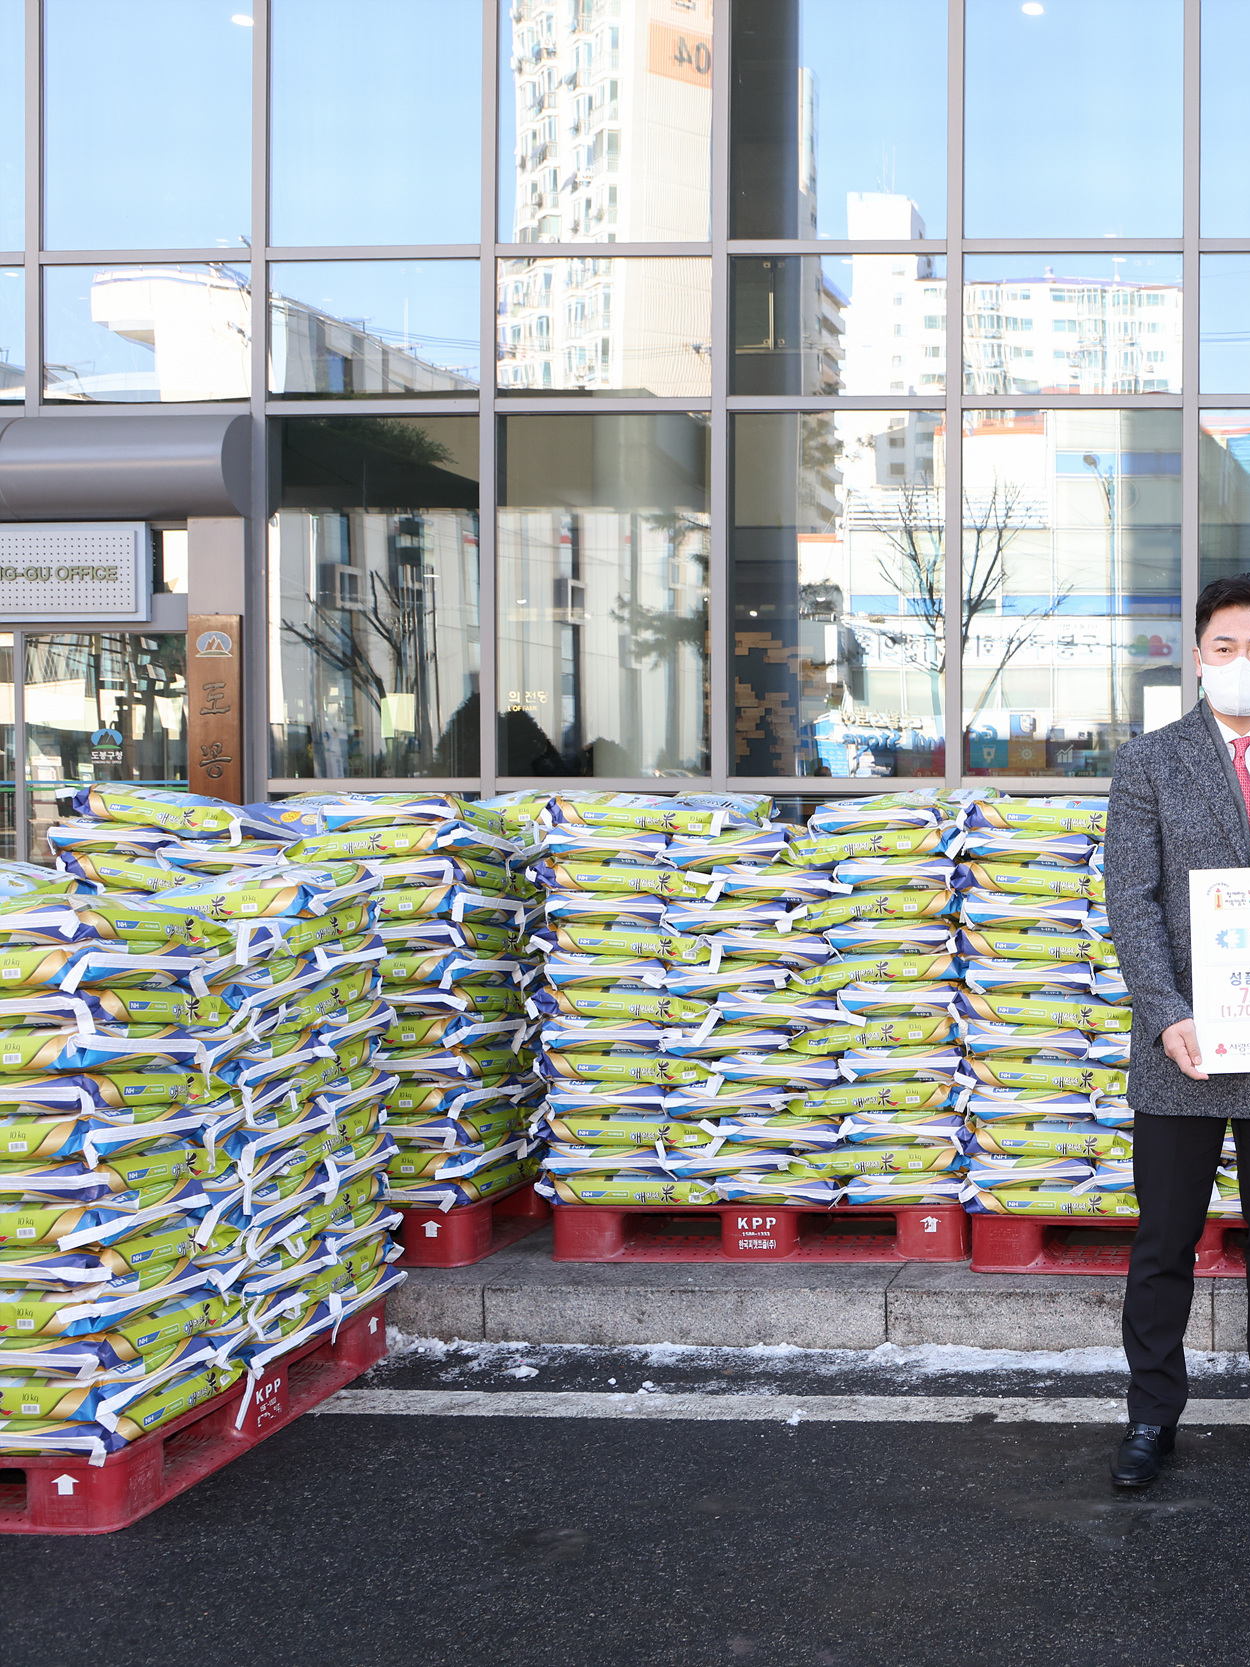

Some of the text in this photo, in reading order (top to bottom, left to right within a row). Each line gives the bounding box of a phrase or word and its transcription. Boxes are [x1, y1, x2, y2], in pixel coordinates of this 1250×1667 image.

[0, 565, 118, 582] G-GU OFFICE
[91, 751, 123, 760] 도봉구청
[330, 1010, 341, 1018] NH
[124, 1087, 135, 1095] NH
[334, 1150, 345, 1158] NH
[257, 1189, 268, 1198] NH
[737, 1217, 777, 1229] KPP
[255, 1378, 282, 1405] KPP
[144, 1415, 155, 1424] NH
